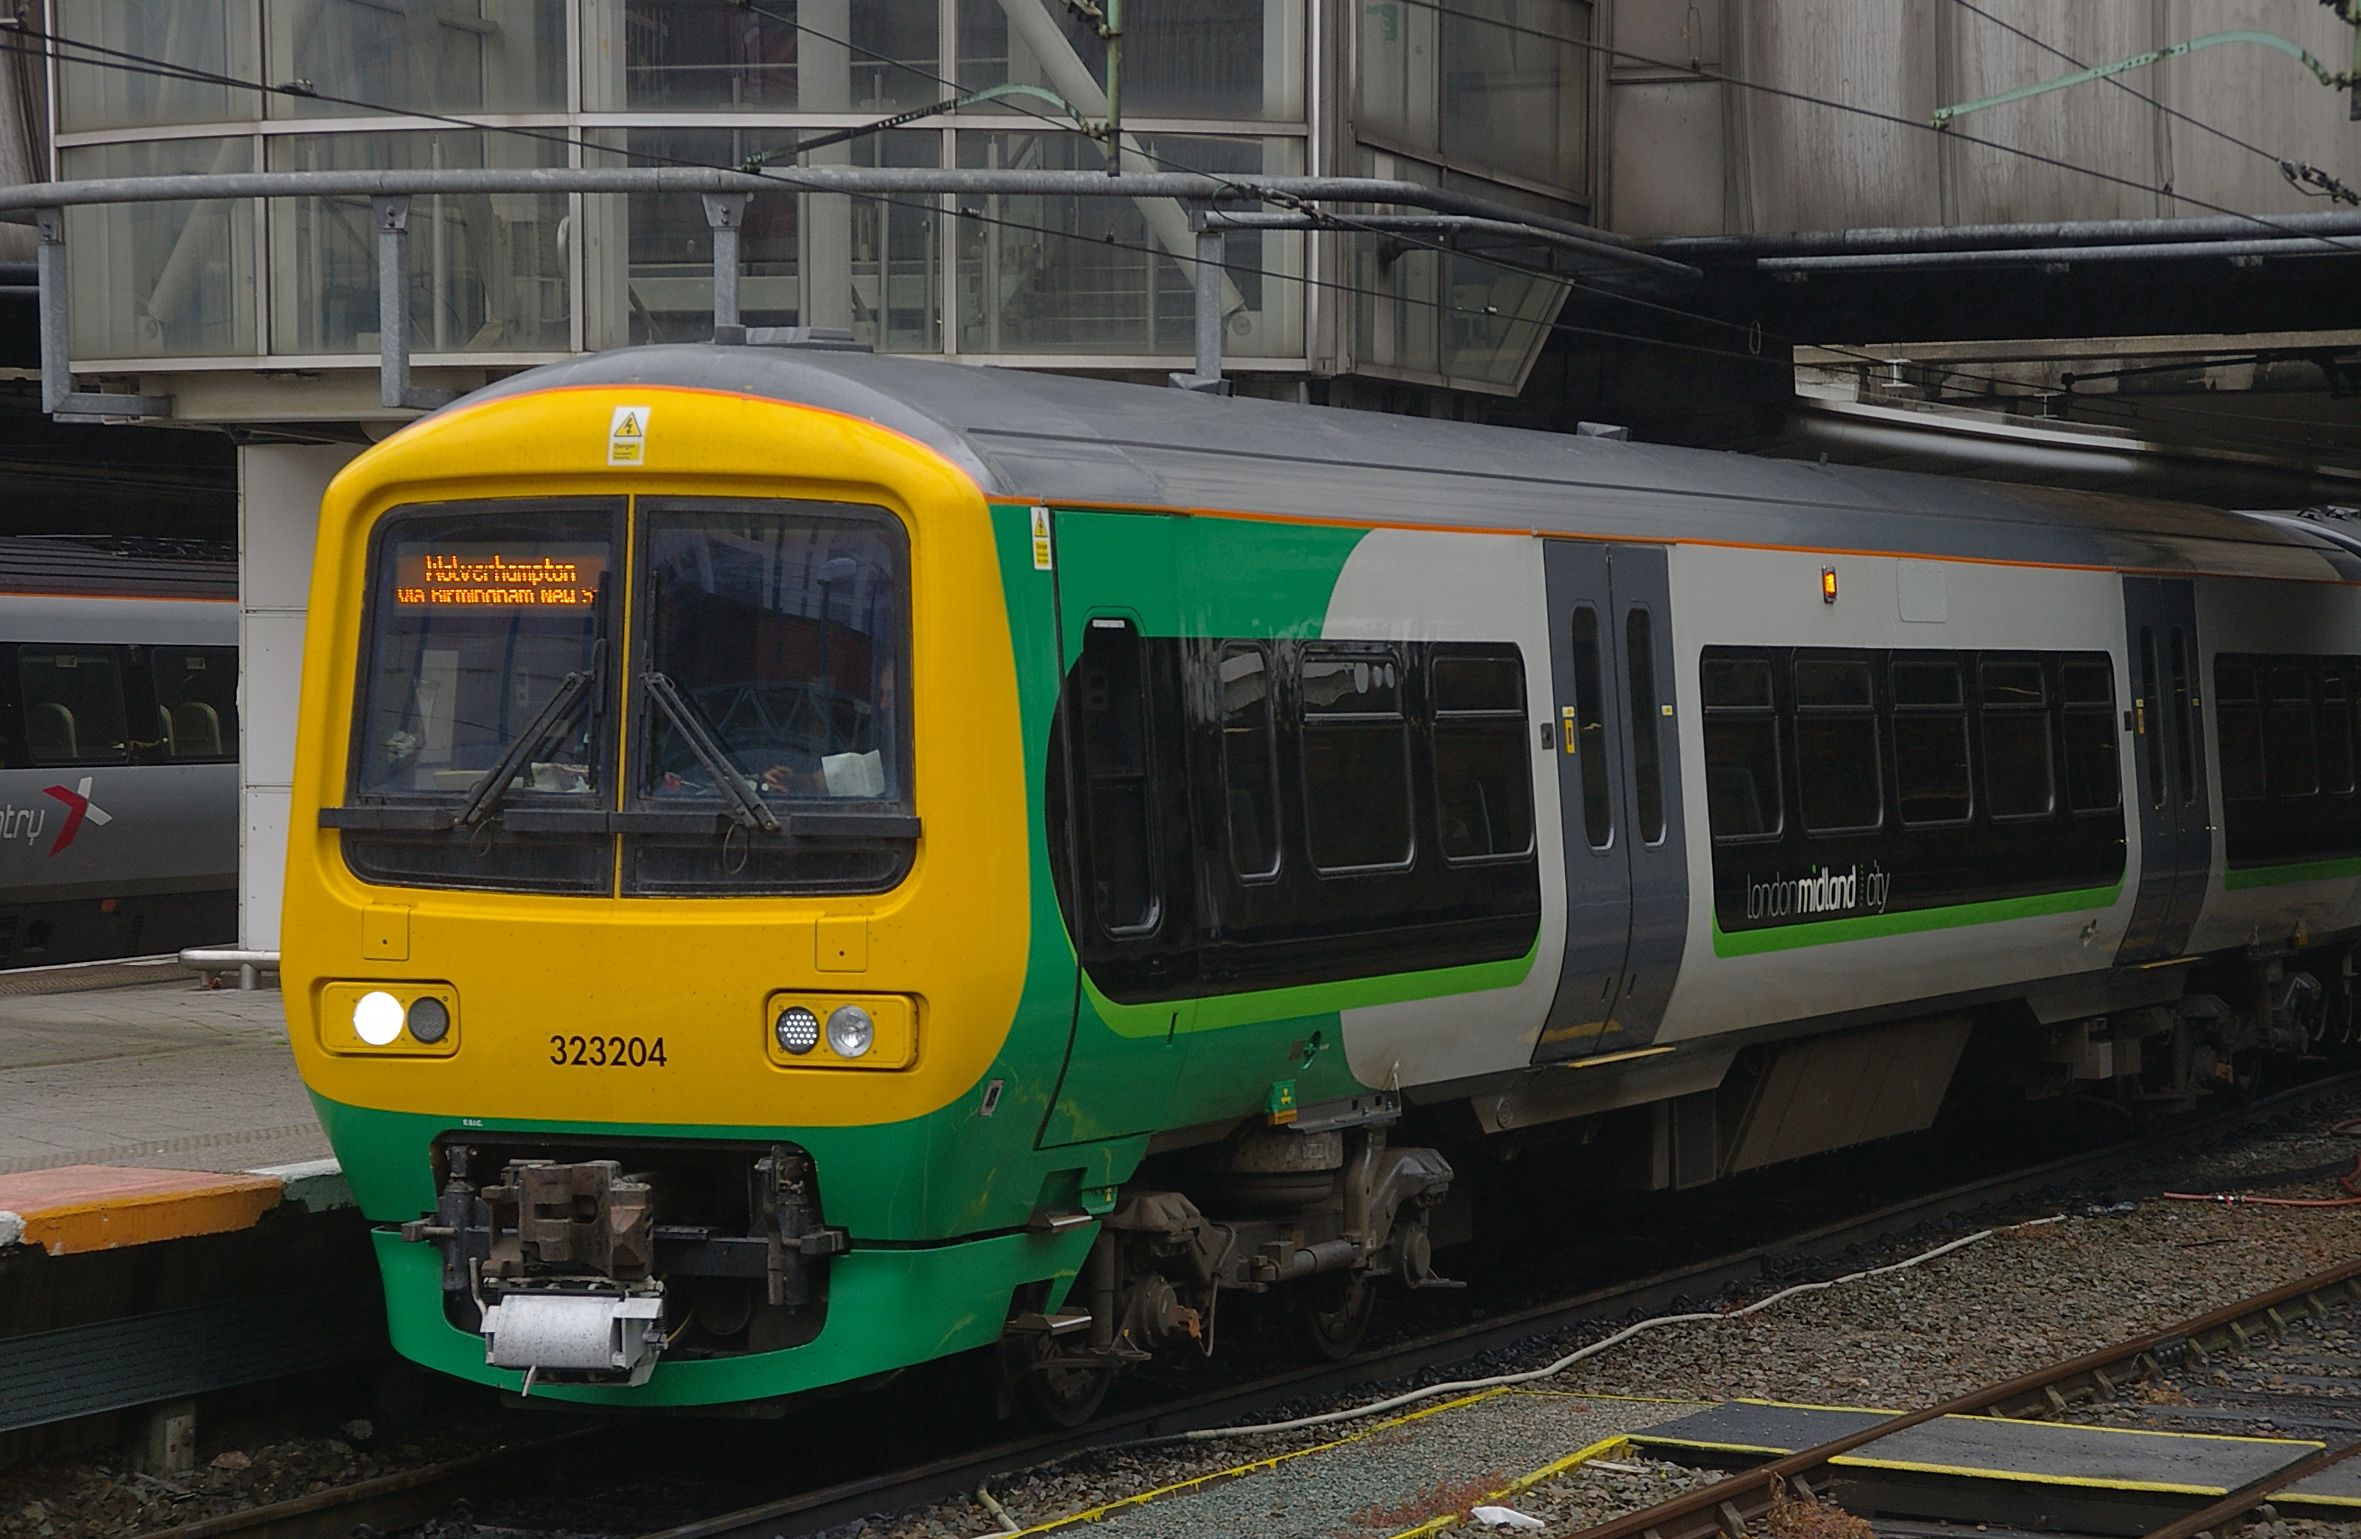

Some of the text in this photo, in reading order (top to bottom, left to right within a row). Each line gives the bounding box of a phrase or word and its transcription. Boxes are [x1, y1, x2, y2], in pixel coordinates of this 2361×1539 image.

[425, 555, 577, 586] Wolverhampton
[1866, 859, 1891, 913] city
[550, 1035, 668, 1067] 323204
